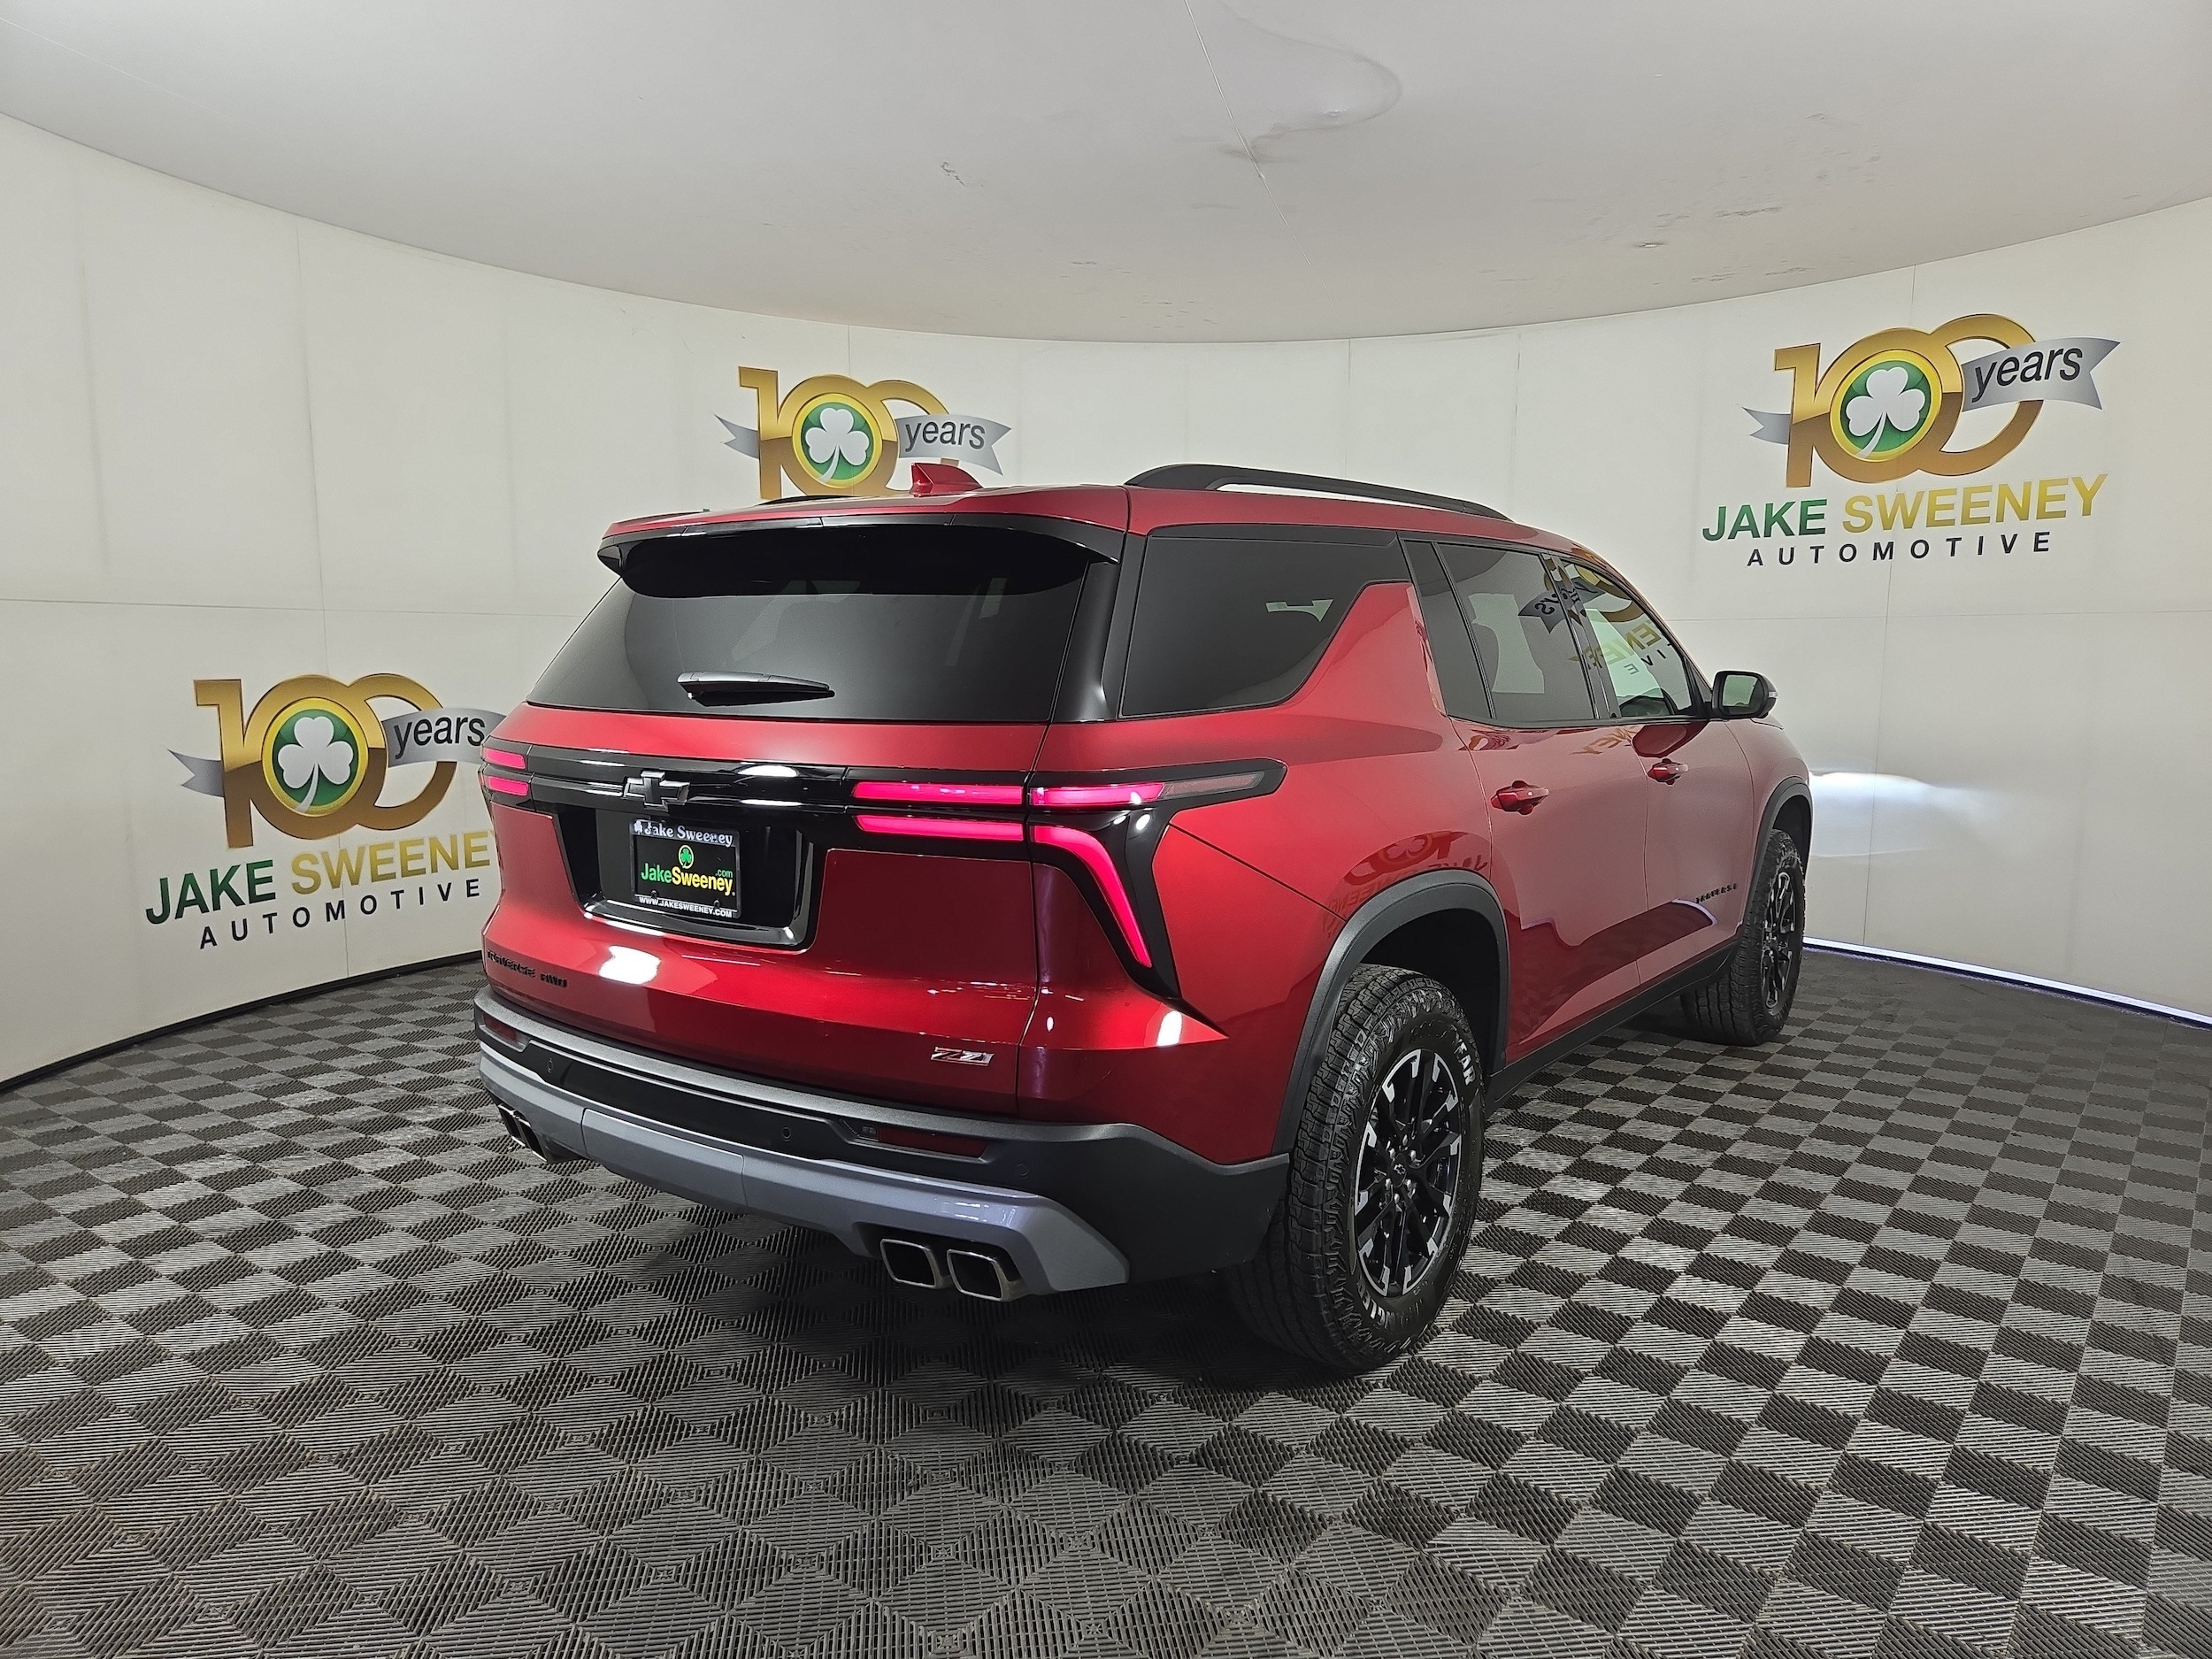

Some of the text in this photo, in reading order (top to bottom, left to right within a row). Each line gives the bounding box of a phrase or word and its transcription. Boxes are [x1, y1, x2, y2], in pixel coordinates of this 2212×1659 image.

[1774, 313, 2083, 488] 100 years
[905, 420, 986, 452] years
[1702, 473, 2108, 541] JAKE SWEENEY
[1747, 531, 2051, 567] AUTOMOTIVE
[193, 672, 486, 849] 100 years
[644, 821, 733, 848] Jake Sweeney
[145, 830, 496, 926] JAKE SWEENE
[638, 895, 733, 918] WWW.JAKESWEENEY.COM
[199, 879, 480, 950] AUTOMOTIVE
